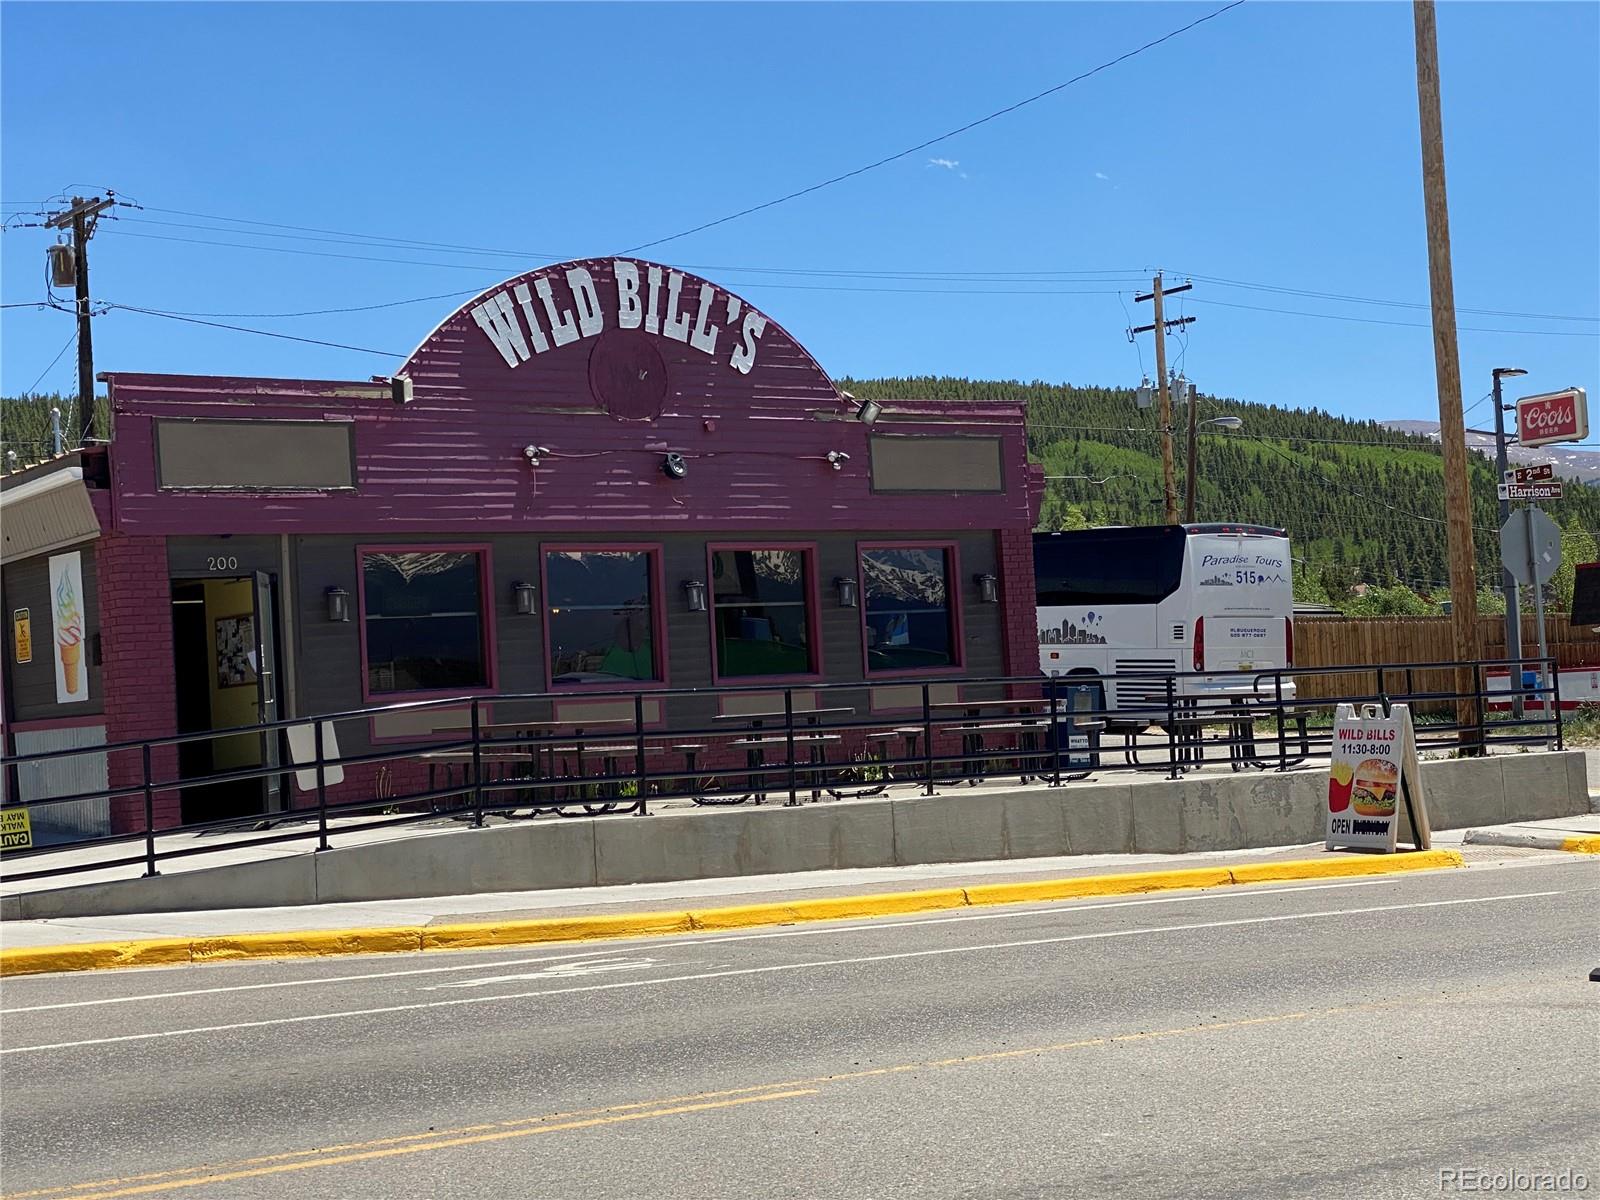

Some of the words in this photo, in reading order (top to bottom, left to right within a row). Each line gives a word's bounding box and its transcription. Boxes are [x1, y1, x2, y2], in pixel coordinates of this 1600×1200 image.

[470, 266, 604, 369] WILD
[613, 260, 767, 375] BILL'S
[1524, 406, 1573, 429] Coors
[1526, 467, 1541, 480] 2nd
[1543, 467, 1551, 475] St
[1509, 485, 1552, 498] Harrison
[1550, 486, 1561, 494] Ave
[207, 556, 238, 571] 200
[1201, 554, 1249, 567] Paradise
[1255, 555, 1283, 568] Tours
[1236, 570, 1256, 584] 515
[1338, 728, 1364, 741] WILD
[1366, 729, 1396, 741] BILLS
[1341, 743, 1391, 755] 11:30-8:00
[7, 812, 25, 821] MAY
[1331, 818, 1351, 834] OPEN
